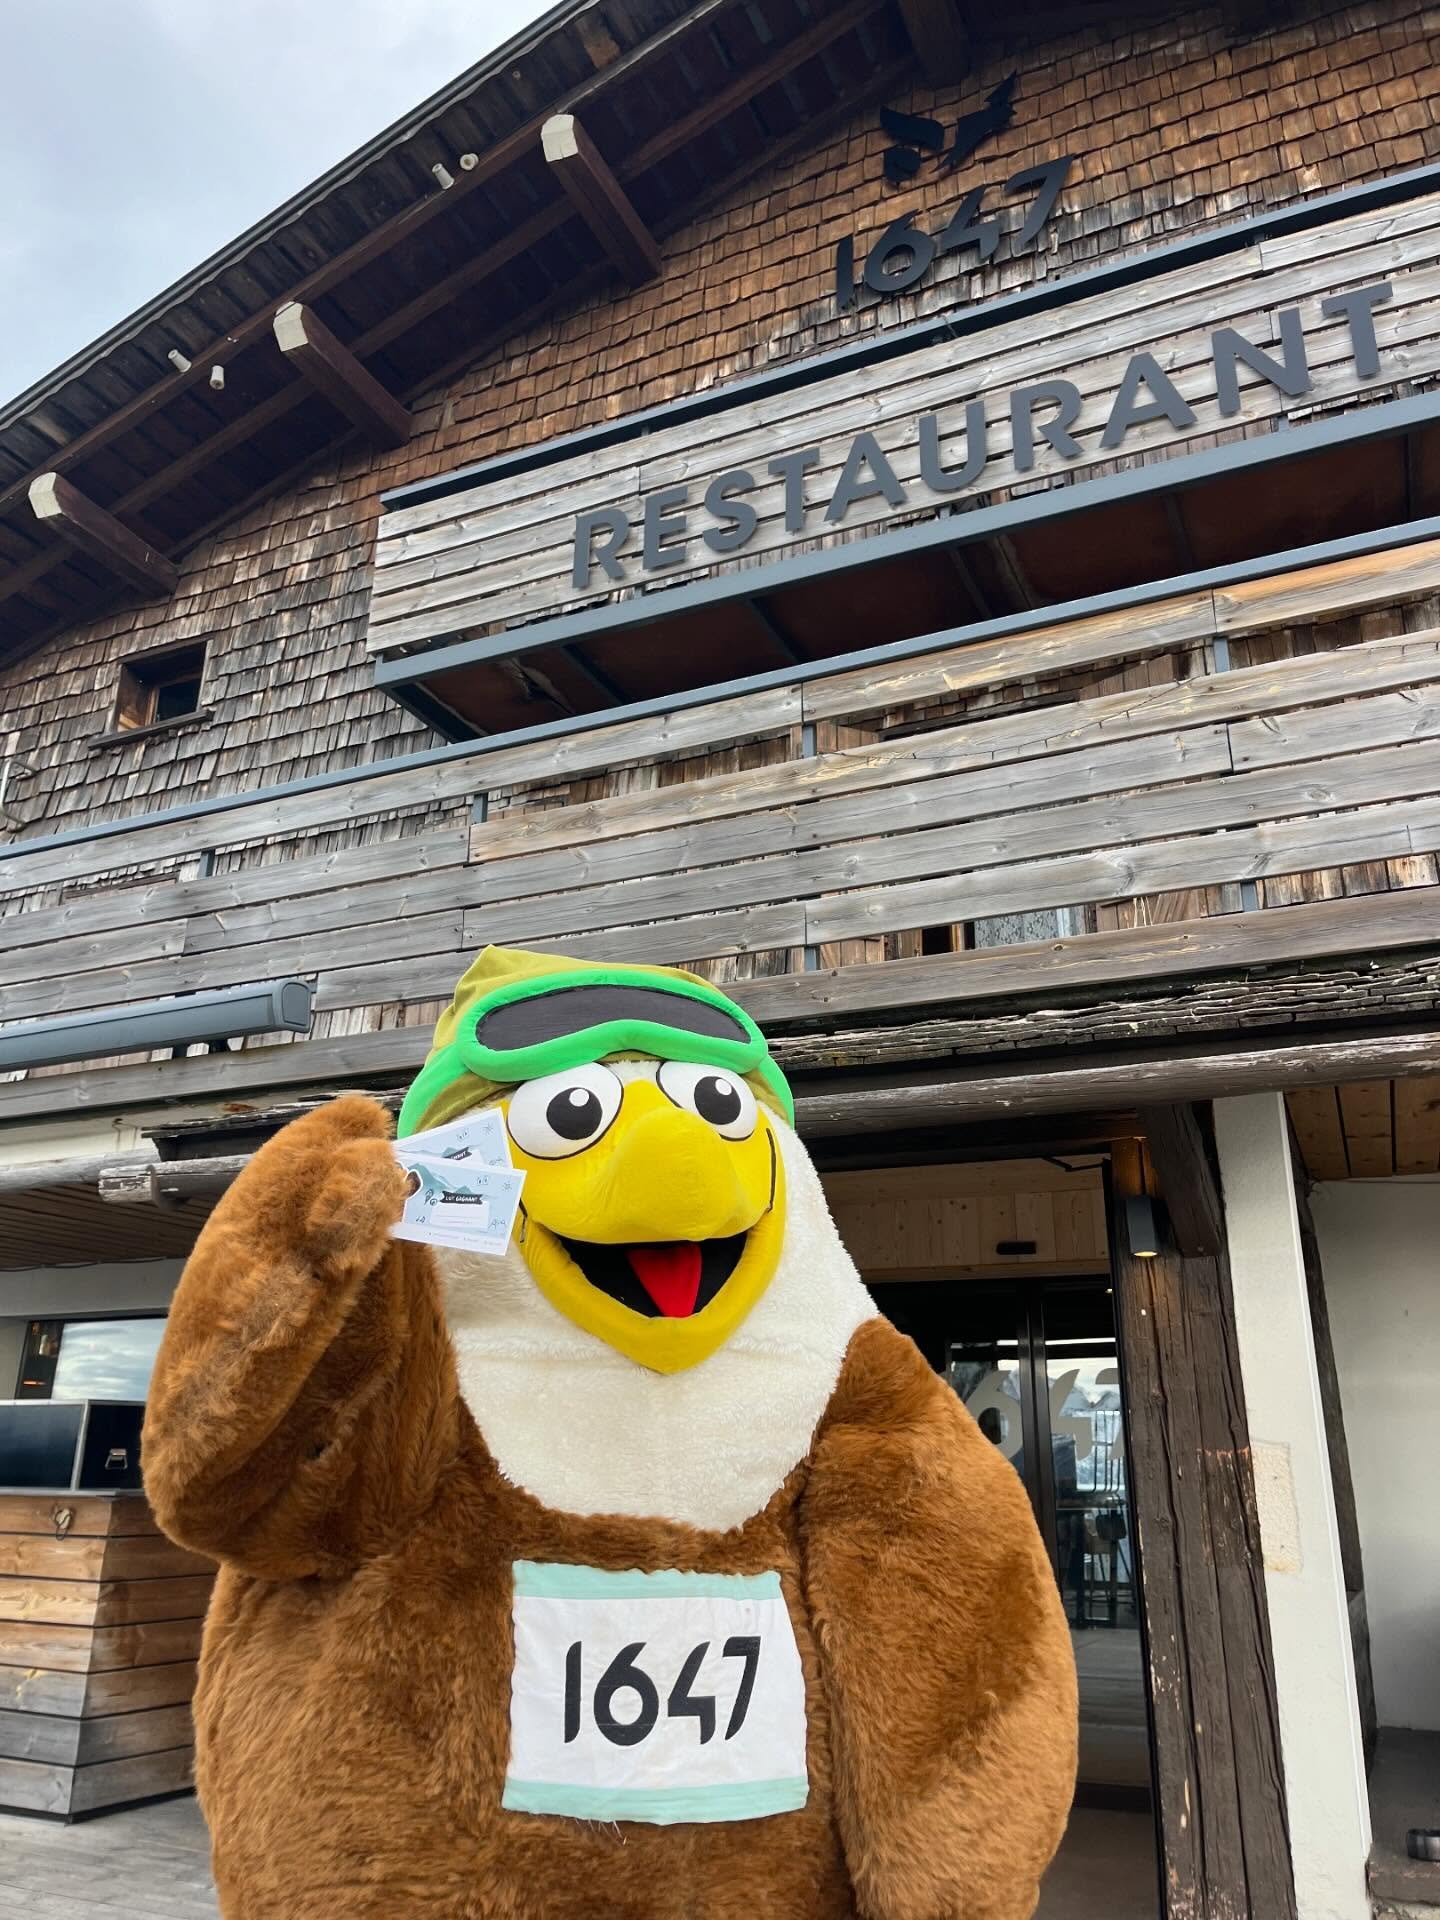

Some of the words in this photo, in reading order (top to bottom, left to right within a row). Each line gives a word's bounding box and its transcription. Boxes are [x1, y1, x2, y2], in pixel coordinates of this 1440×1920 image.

[836, 153, 1076, 311] 1647
[572, 282, 1394, 589] RESTAURANT
[564, 1635, 762, 1747] 1647
